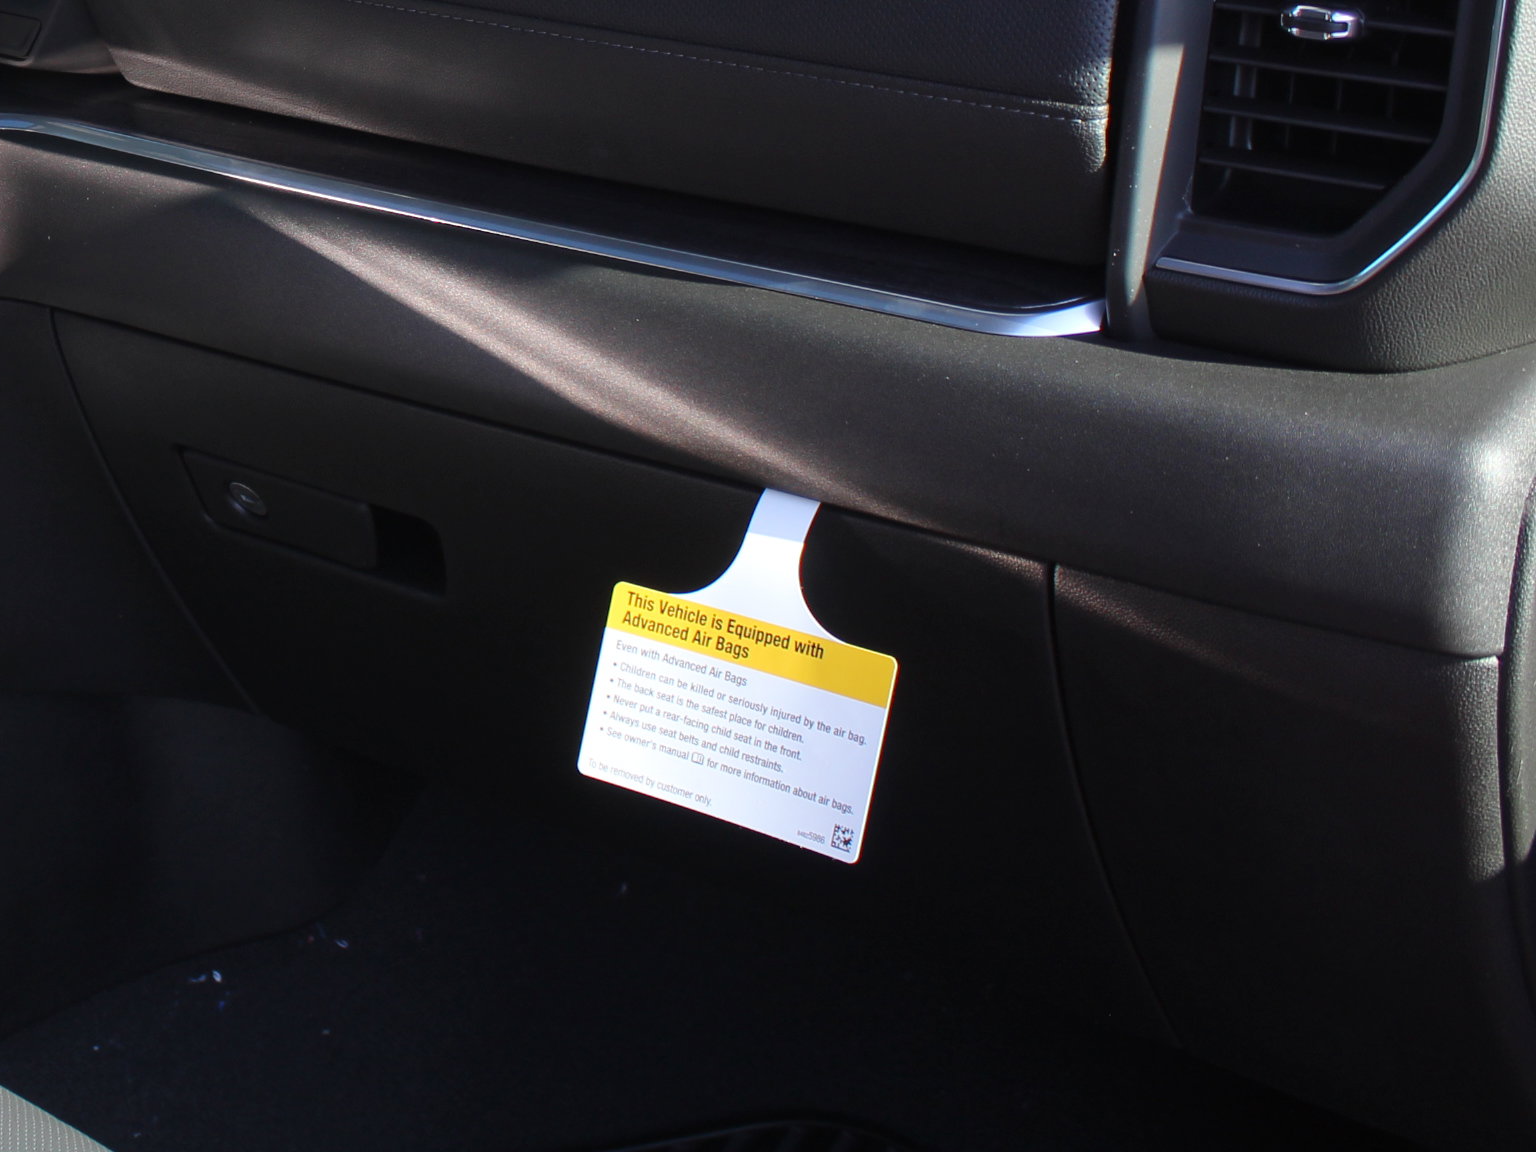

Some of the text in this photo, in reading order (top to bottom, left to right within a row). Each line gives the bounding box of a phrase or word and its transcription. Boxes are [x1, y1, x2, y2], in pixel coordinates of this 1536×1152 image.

[622, 610, 749, 659] Advanced Air Bags
[628, 590, 824, 659] This Vehicle is Equipped with
[615, 640, 747, 686] Even with Advanced Air Bags
[613, 694, 801, 760] Never put a rear-facing child seat in the front.
[617, 677, 803, 743] The back seat is the safest place for children.
[620, 662, 866, 745] Children can be killed or seriously injured by the air bag.
[606, 726, 853, 814] See owner's manual for more information about air bags.
[609, 711, 783, 773] Always use seat belts and child restraints.
